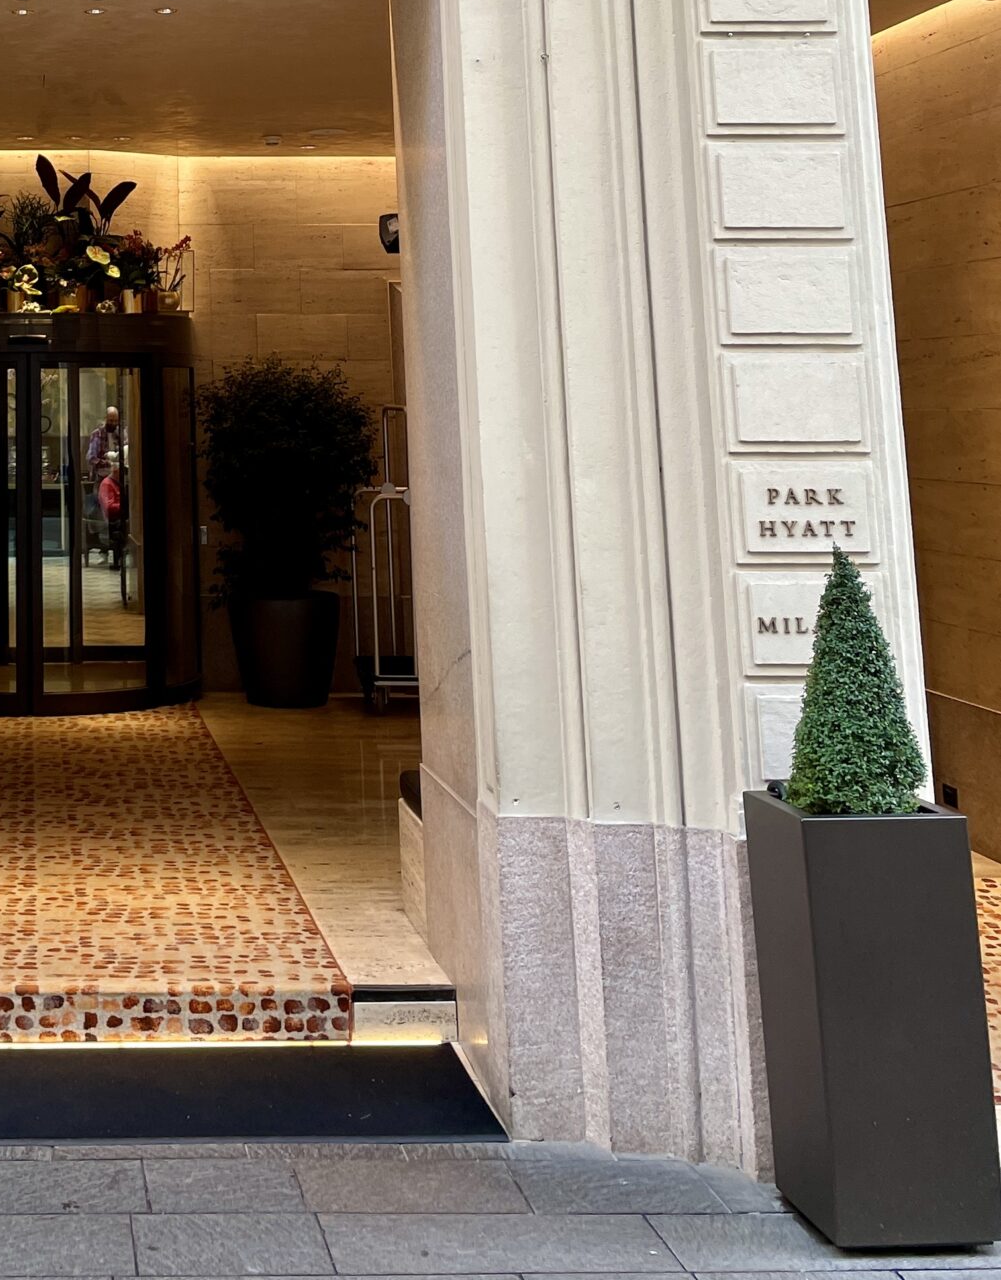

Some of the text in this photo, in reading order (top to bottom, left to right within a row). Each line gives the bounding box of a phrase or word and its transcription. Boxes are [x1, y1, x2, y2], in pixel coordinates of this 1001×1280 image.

[766, 488, 845, 506] PARK
[758, 520, 856, 538] HYATT
[757, 616, 809, 635] MIL
